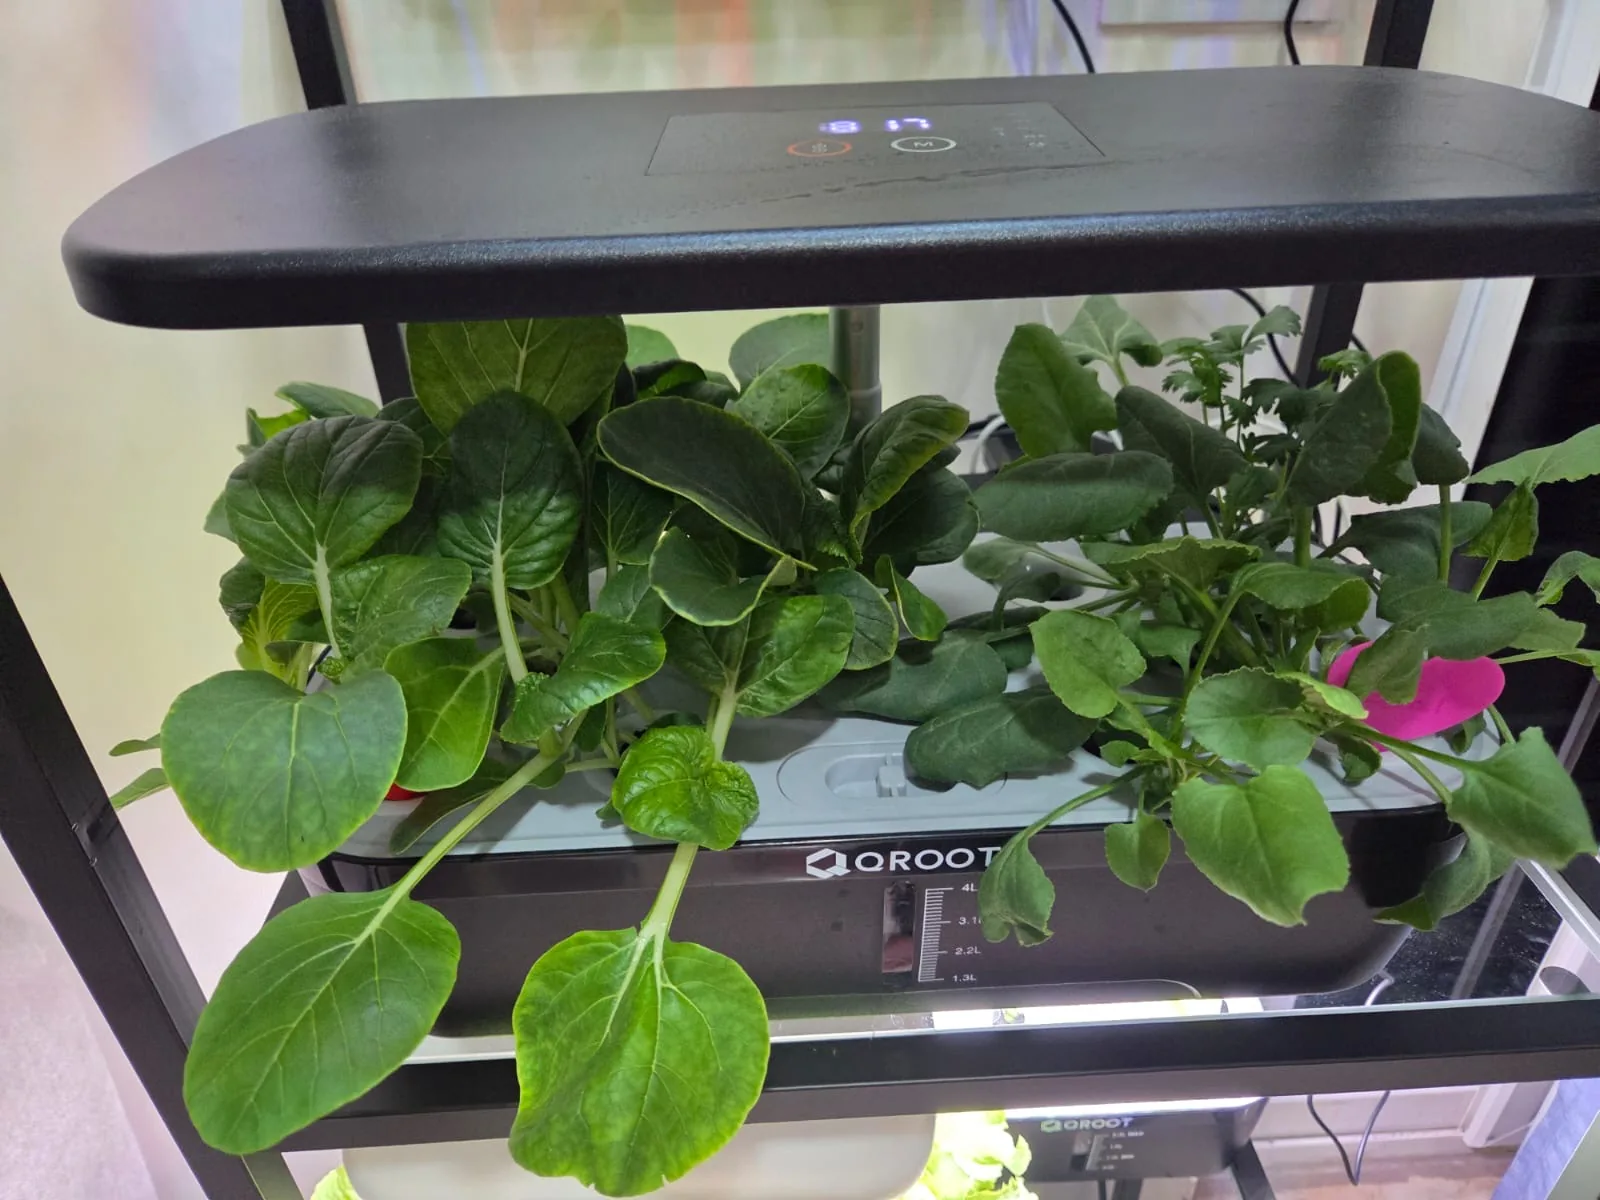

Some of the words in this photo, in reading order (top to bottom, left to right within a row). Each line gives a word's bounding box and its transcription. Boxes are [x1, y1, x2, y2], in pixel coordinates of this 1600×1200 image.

[854, 846, 1001, 872] QROOT
[961, 882, 979, 892] 4L
[954, 945, 982, 955] 2.2L
[952, 973, 977, 982] 1.3L
